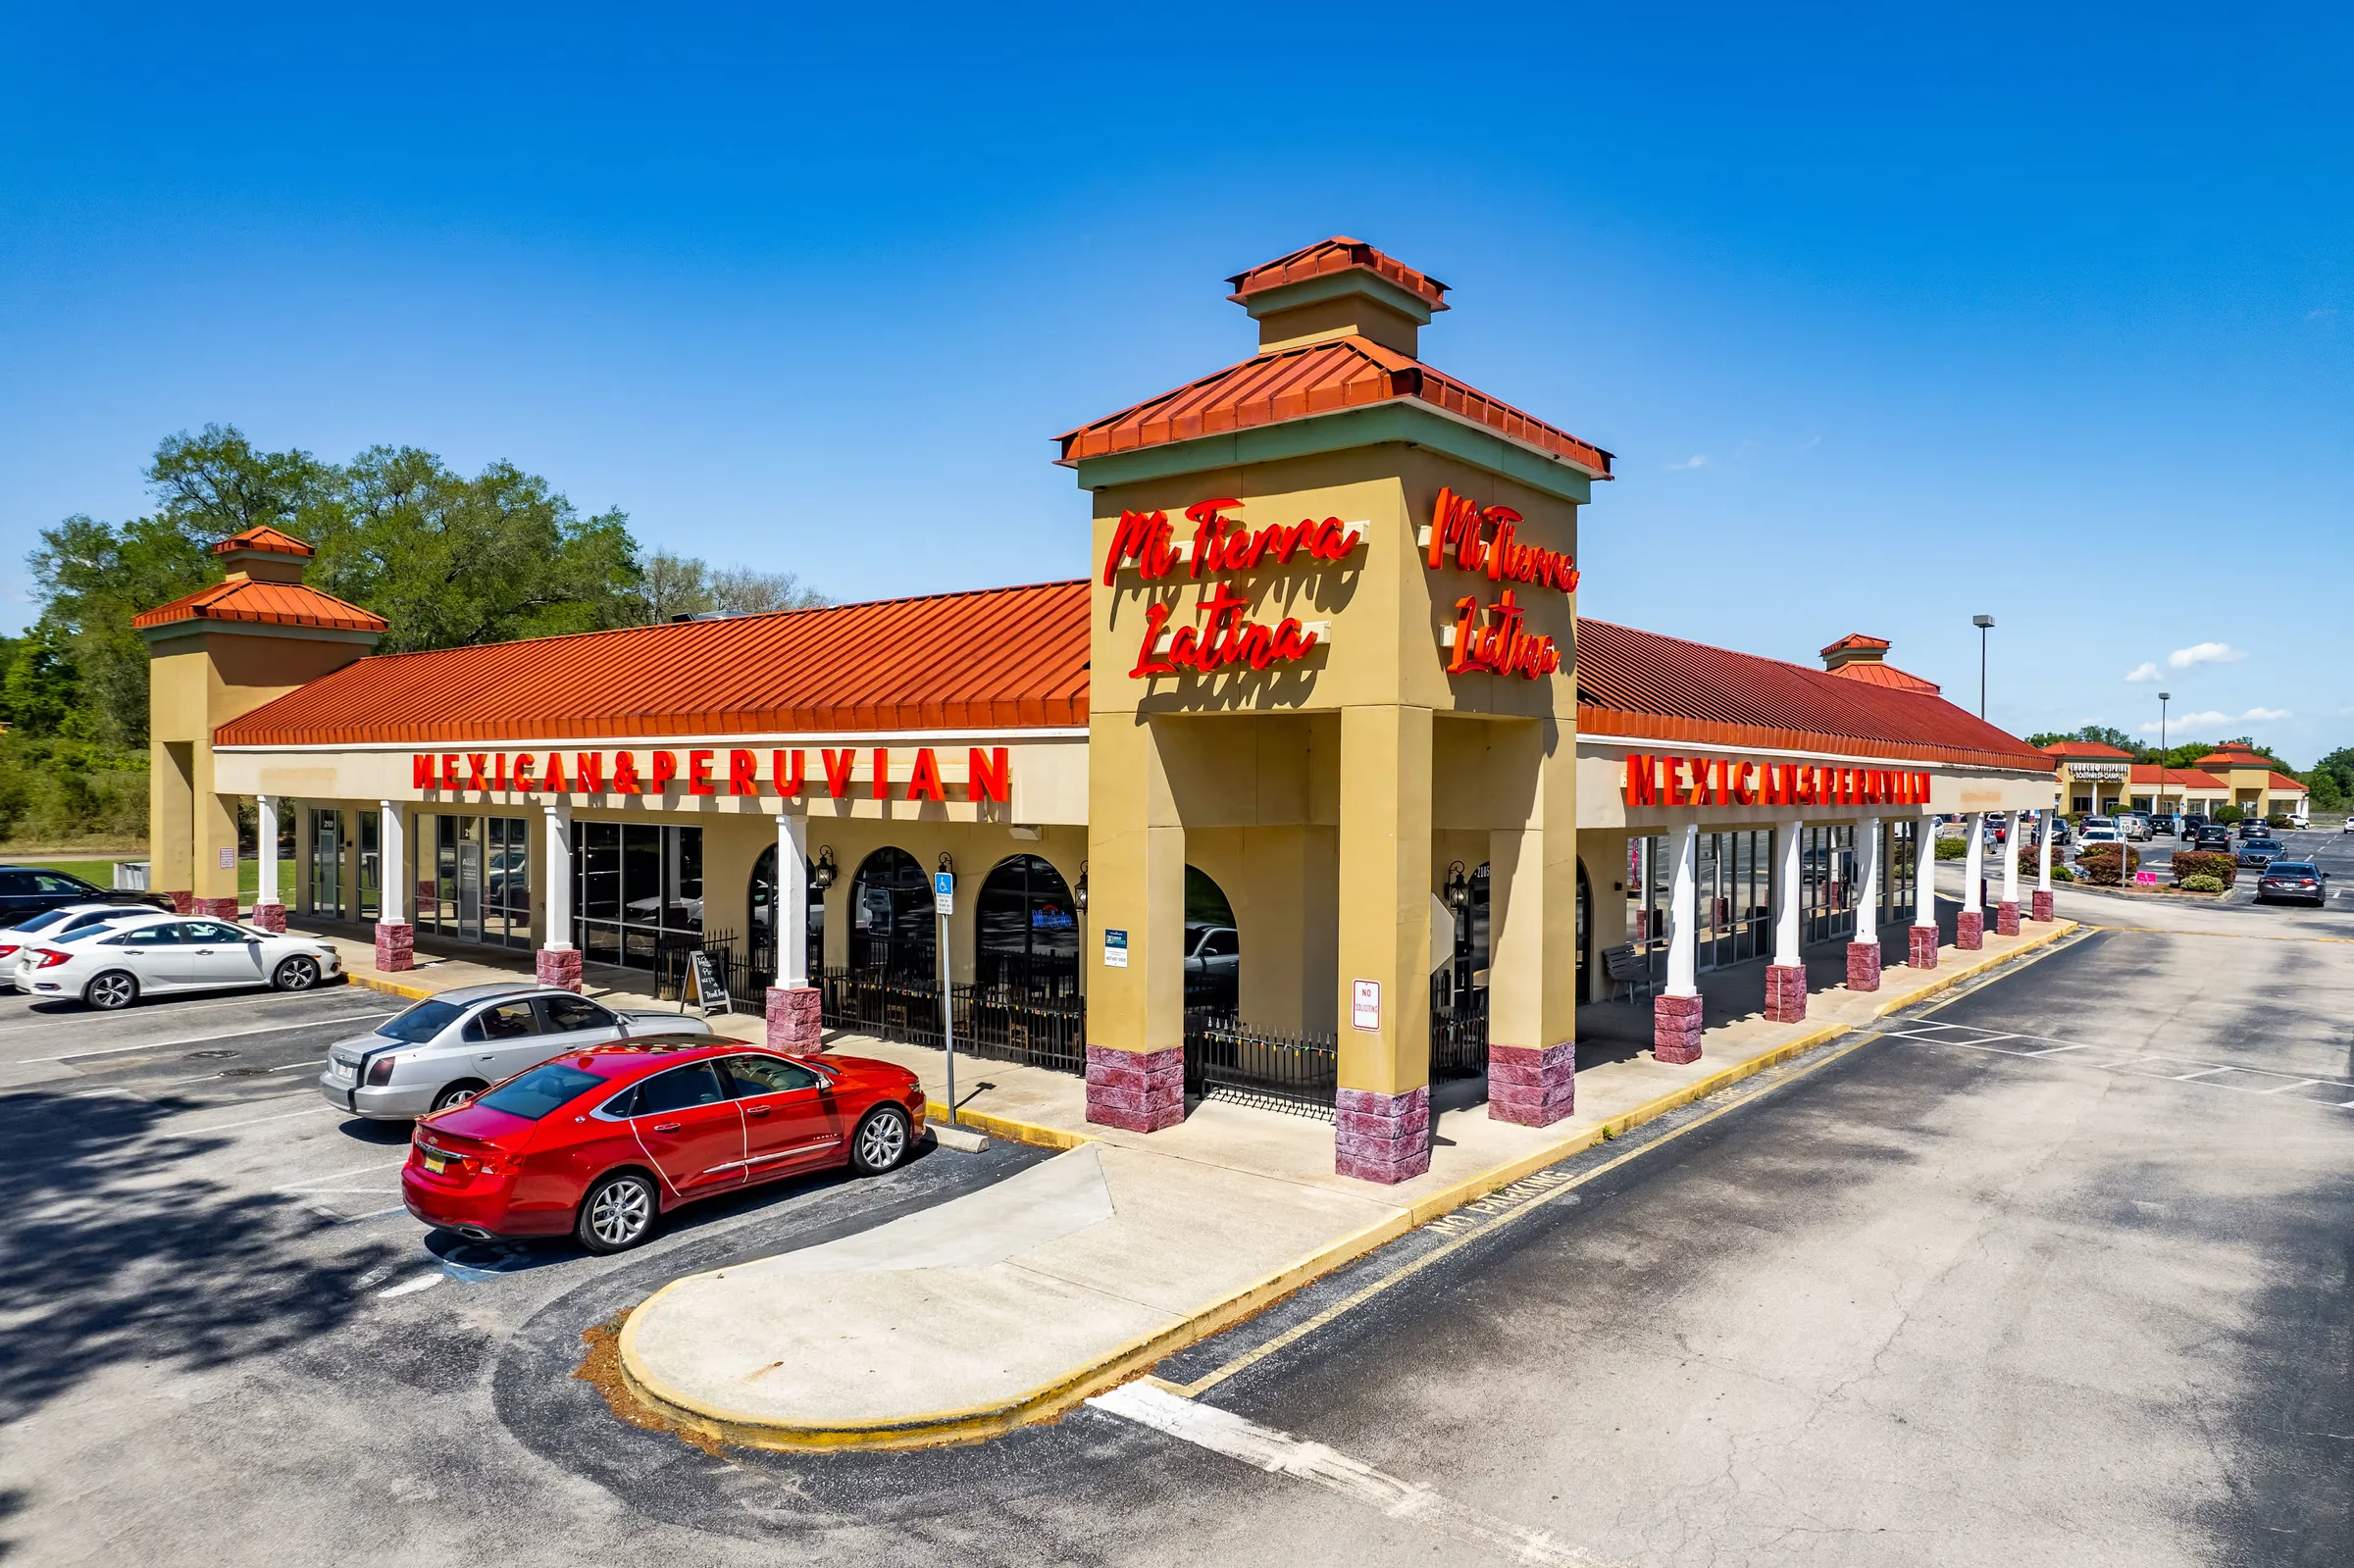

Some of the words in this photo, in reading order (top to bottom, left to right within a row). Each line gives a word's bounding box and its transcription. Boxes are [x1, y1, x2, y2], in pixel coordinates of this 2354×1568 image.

[1103, 509, 1182, 587] Mi
[1185, 497, 1361, 580] Tierra
[1428, 486, 1489, 572] Mi
[1483, 505, 1580, 593] Tierra
[1129, 582, 1319, 680] Latina
[1446, 588, 1562, 681] Latina
[1356, 1003, 1378, 1013] SOLICITING
[1361, 988, 1371, 997] NO
[1424, 1214, 1478, 1237] NO
[1465, 1170, 1575, 1216] PARKING
